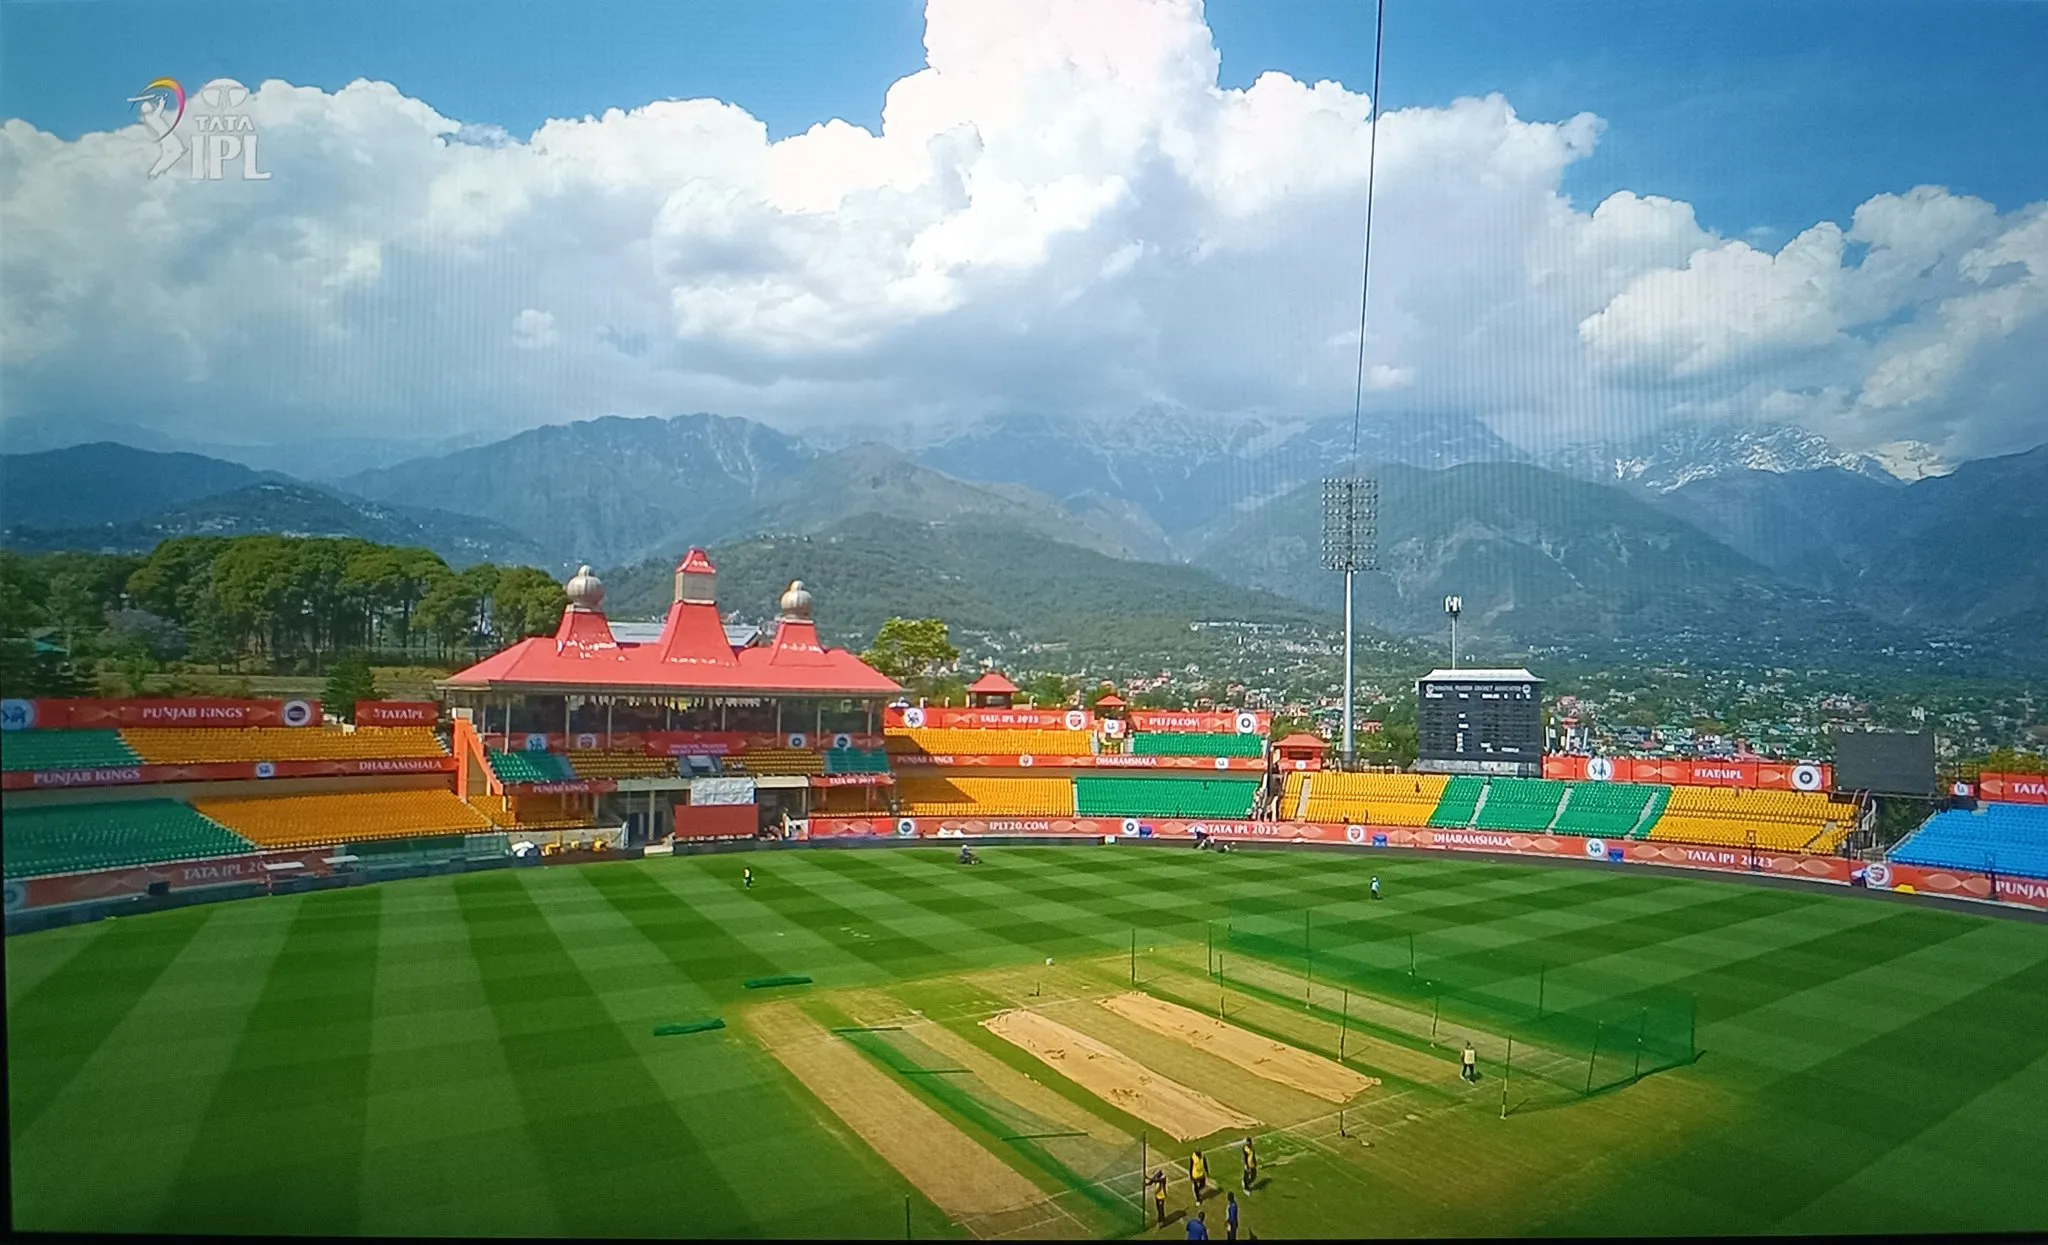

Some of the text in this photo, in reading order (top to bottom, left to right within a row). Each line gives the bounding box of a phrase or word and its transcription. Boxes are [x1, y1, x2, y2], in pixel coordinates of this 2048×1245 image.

[143, 707, 243, 720] PUNJAB KINGS
[360, 761, 442, 770] DHARAMSHALA
[1096, 756, 1157, 767] DHARAMSHALA
[33, 769, 140, 785] PUNJAB KINGS
[989, 821, 1049, 831] IPLT20.COM
[1209, 824, 1279, 836] TATA IPL 2023
[1434, 833, 1512, 846] DHARAMSHALA
[1687, 849, 1716, 862] TATA
[183, 866, 219, 880] TATA
[223, 863, 244, 876] IPL
